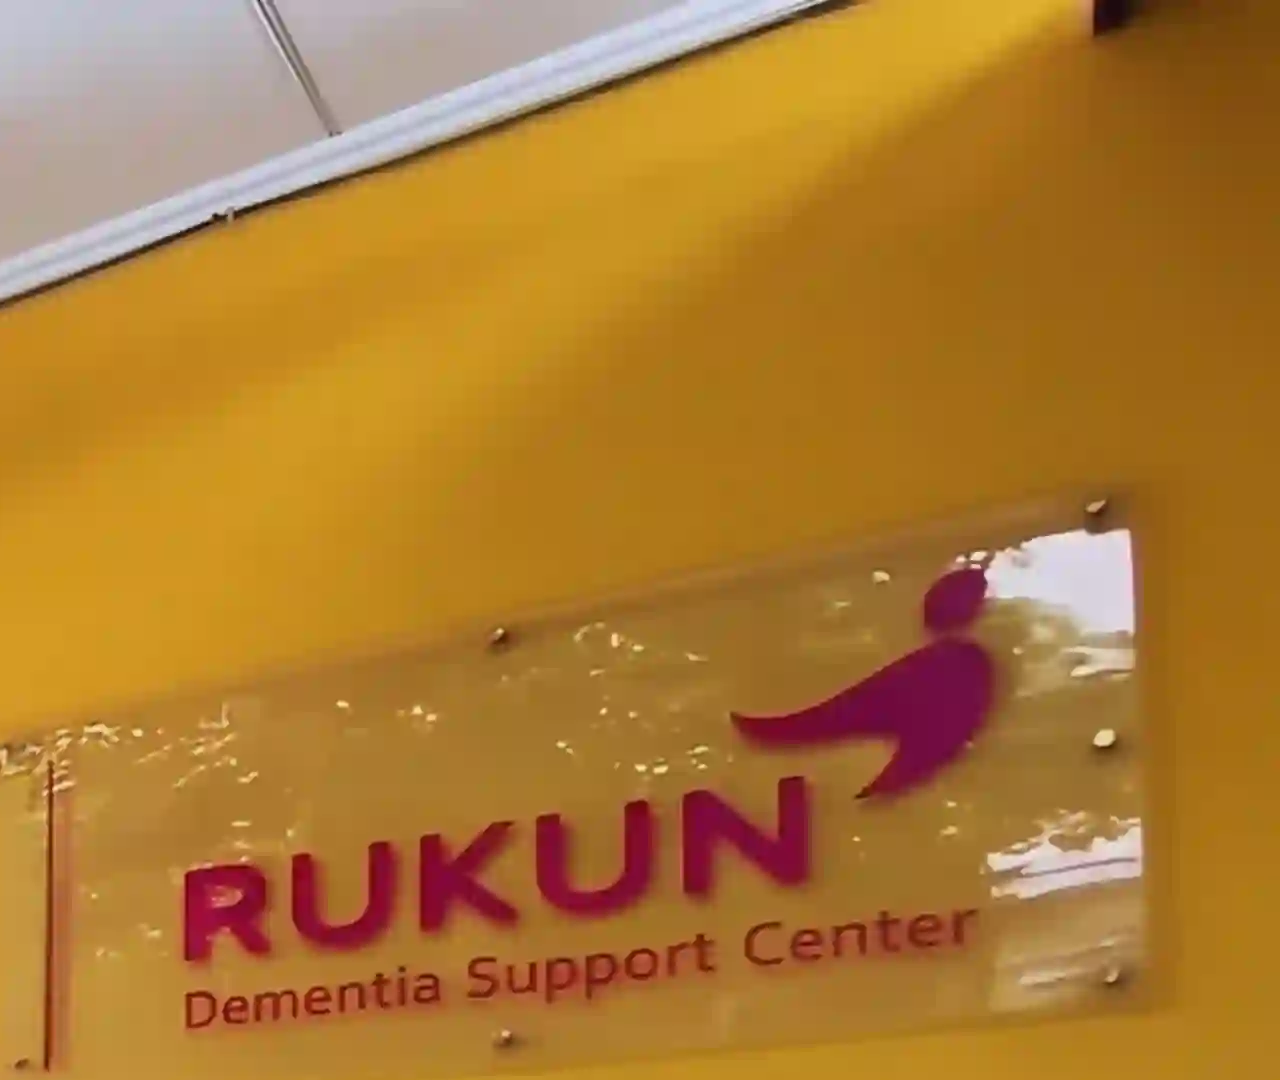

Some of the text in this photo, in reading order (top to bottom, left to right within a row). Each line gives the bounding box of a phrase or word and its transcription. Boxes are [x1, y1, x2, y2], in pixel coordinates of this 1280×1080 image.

[183, 775, 812, 964] RUKUN
[184, 902, 979, 1030] Dementia Support Center
